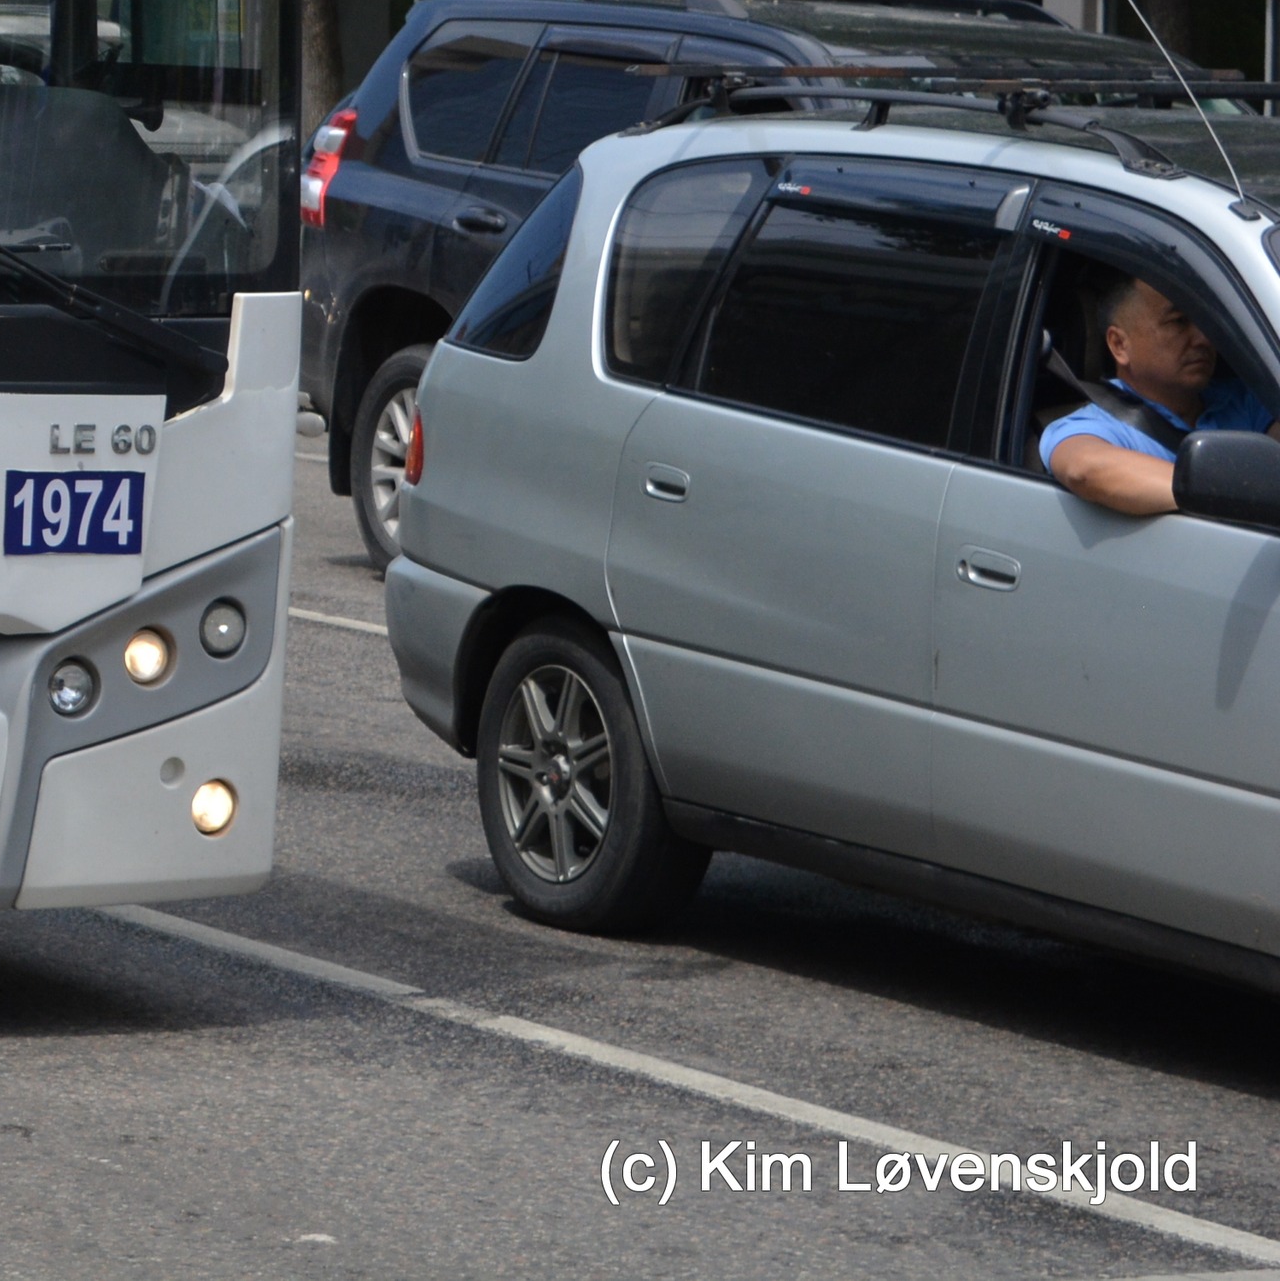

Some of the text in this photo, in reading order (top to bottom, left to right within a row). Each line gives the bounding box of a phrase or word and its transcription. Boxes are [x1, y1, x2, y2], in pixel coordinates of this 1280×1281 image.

[49, 422, 157, 456] LE 60
[13, 478, 134, 547] 1974
